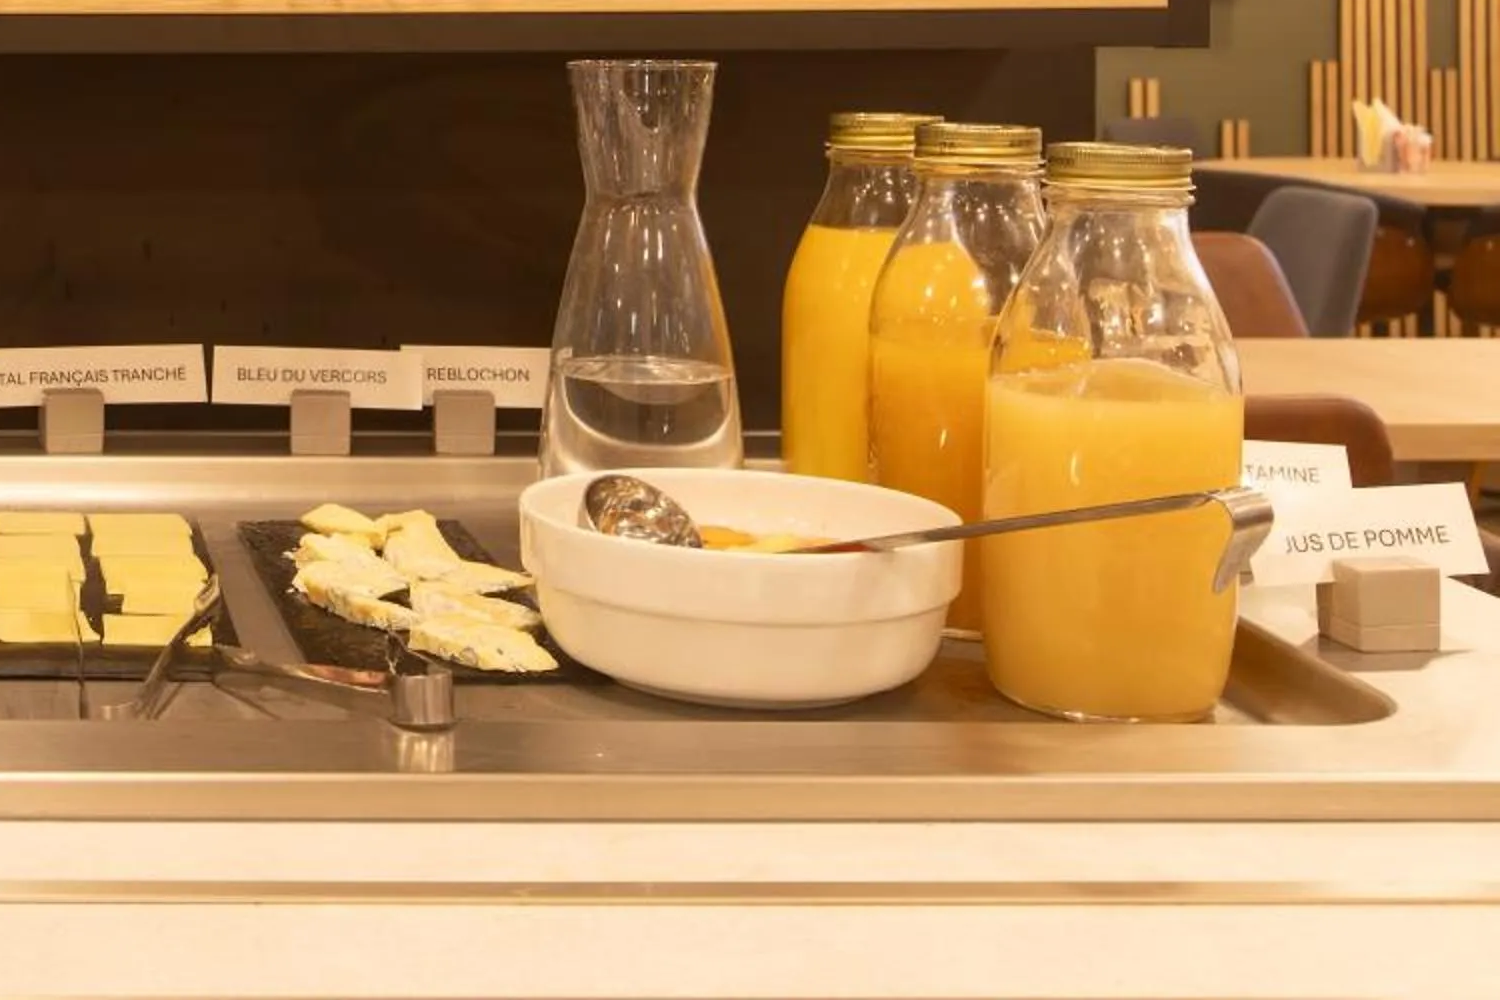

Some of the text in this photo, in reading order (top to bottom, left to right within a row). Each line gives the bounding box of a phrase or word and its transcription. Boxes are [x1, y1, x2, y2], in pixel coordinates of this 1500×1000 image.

[29, 369, 110, 387] FRANÇAIS
[237, 367, 388, 384] BLEU DU VERCORS
[427, 367, 531, 382] REBLOCHON
[1286, 525, 1451, 554] JUS DE POMME
